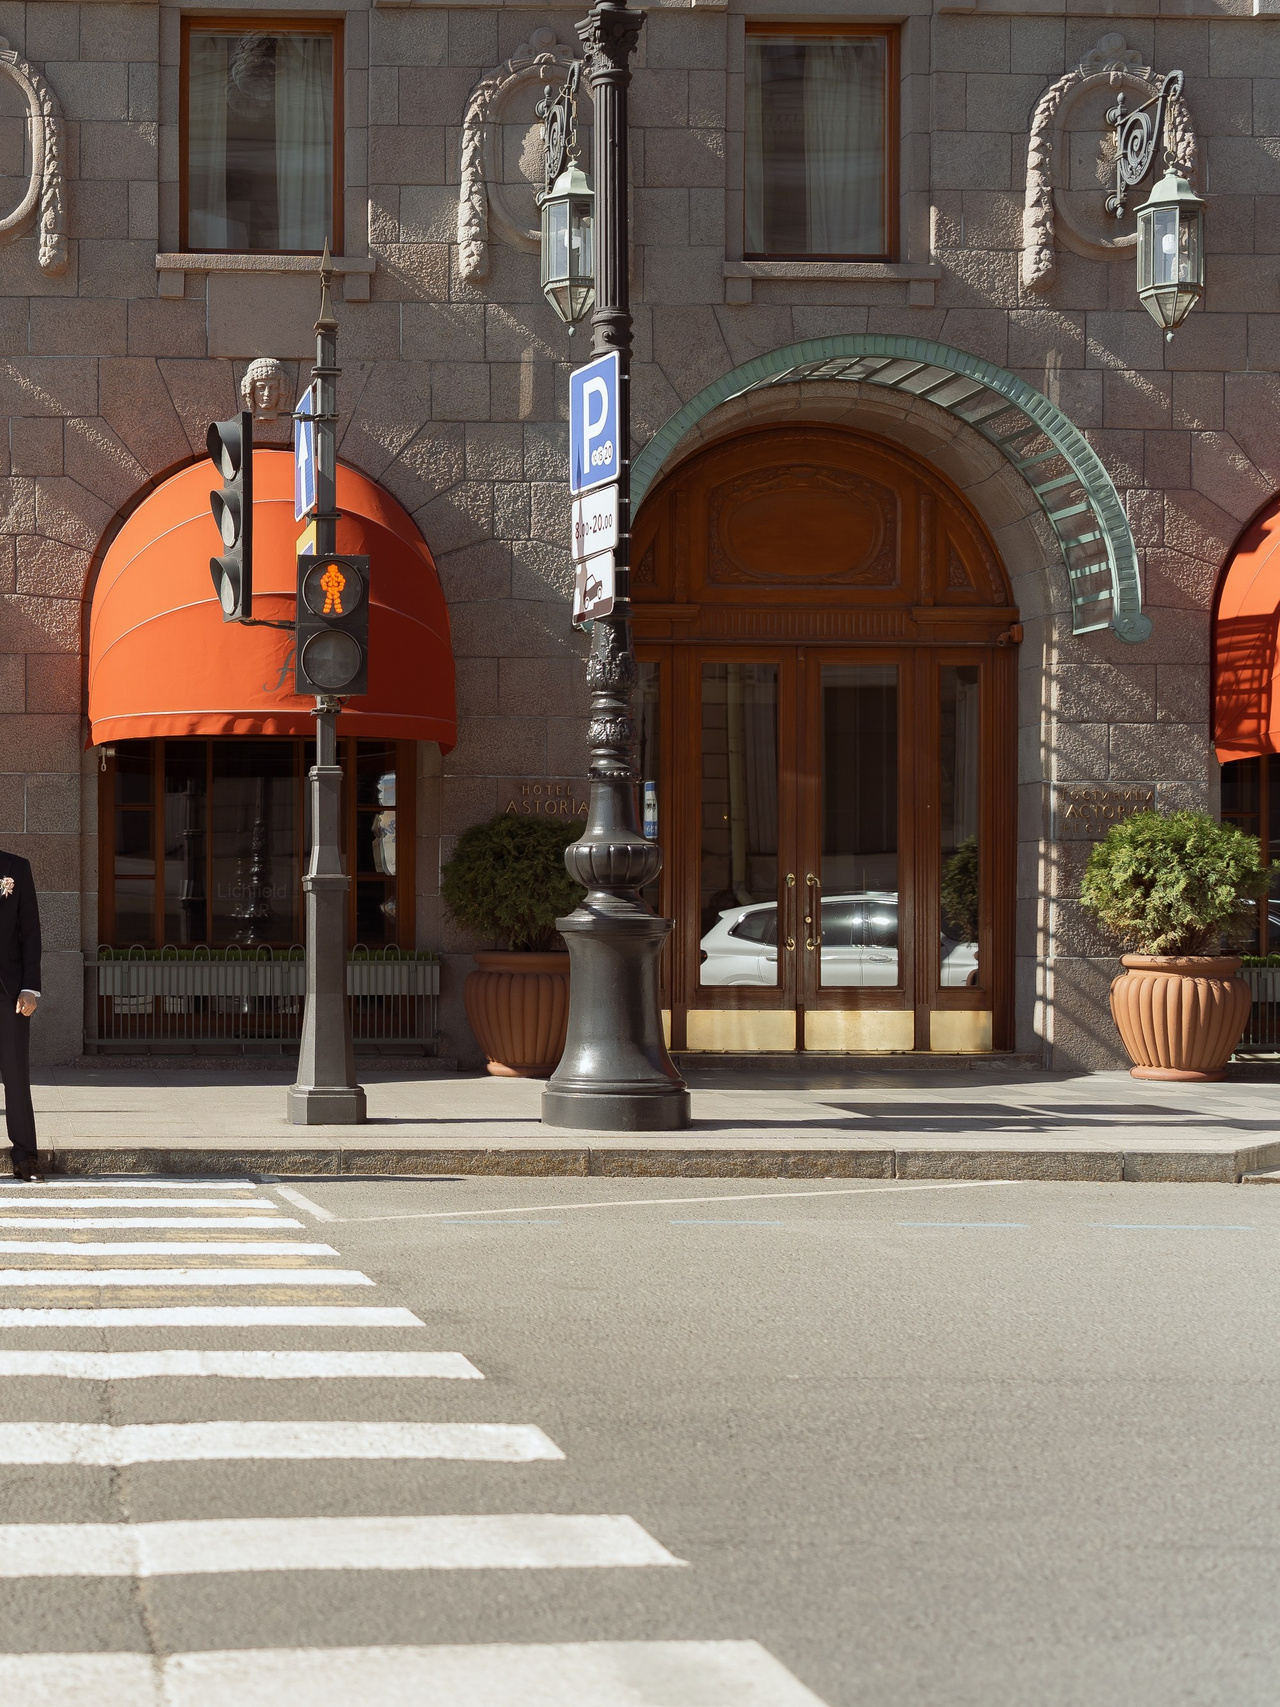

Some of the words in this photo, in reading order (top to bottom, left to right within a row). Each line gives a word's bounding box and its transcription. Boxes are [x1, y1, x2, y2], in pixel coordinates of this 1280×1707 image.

[583, 376, 609, 474] P
[604, 445, 612, 460] 20
[522, 785, 572, 796] HOTEL
[1061, 789, 1155, 802] ГОСТИНИЦА
[505, 798, 589, 815] ASTORIA
[217, 882, 287, 898] Lichfield
[234, 903, 269, 917] BAR
